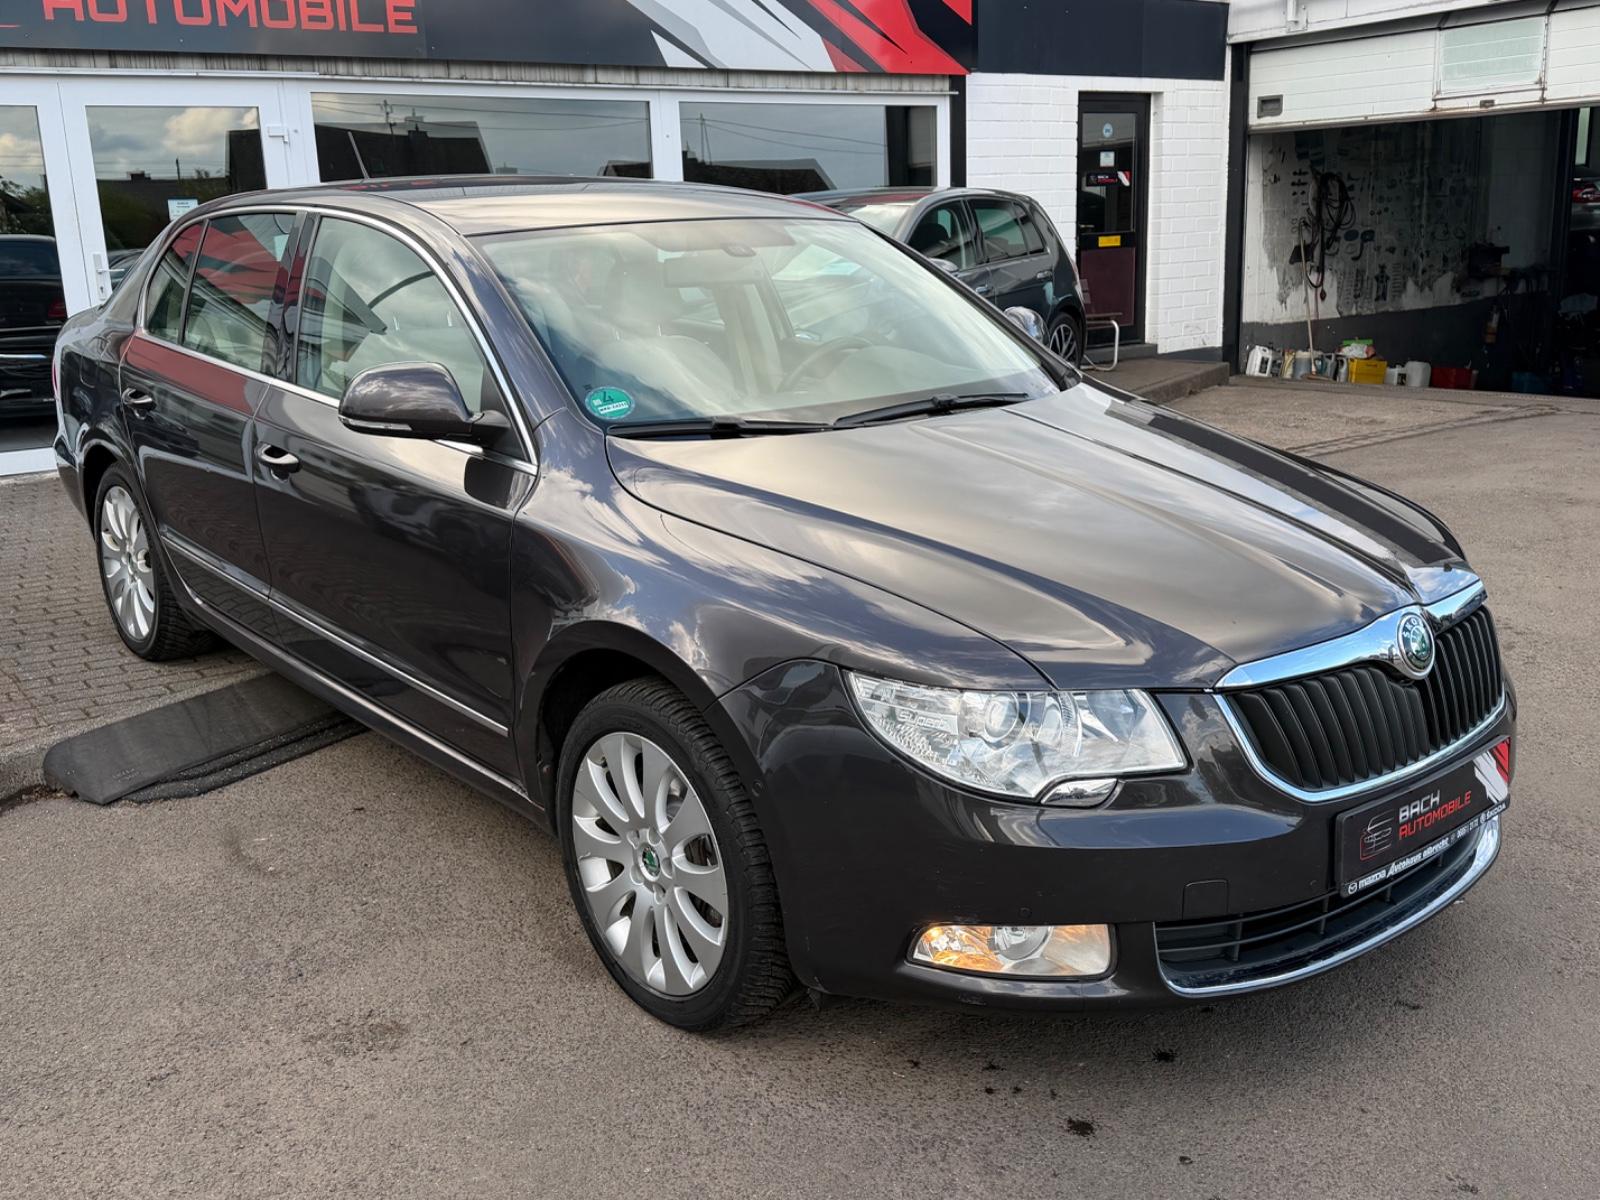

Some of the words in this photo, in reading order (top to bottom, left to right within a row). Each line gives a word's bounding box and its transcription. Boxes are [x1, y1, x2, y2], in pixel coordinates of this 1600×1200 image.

[42, 0, 418, 34] AUTOMOBILE
[1399, 789, 1441, 824] BACH
[1399, 790, 1472, 840] AUTOMOBILE
